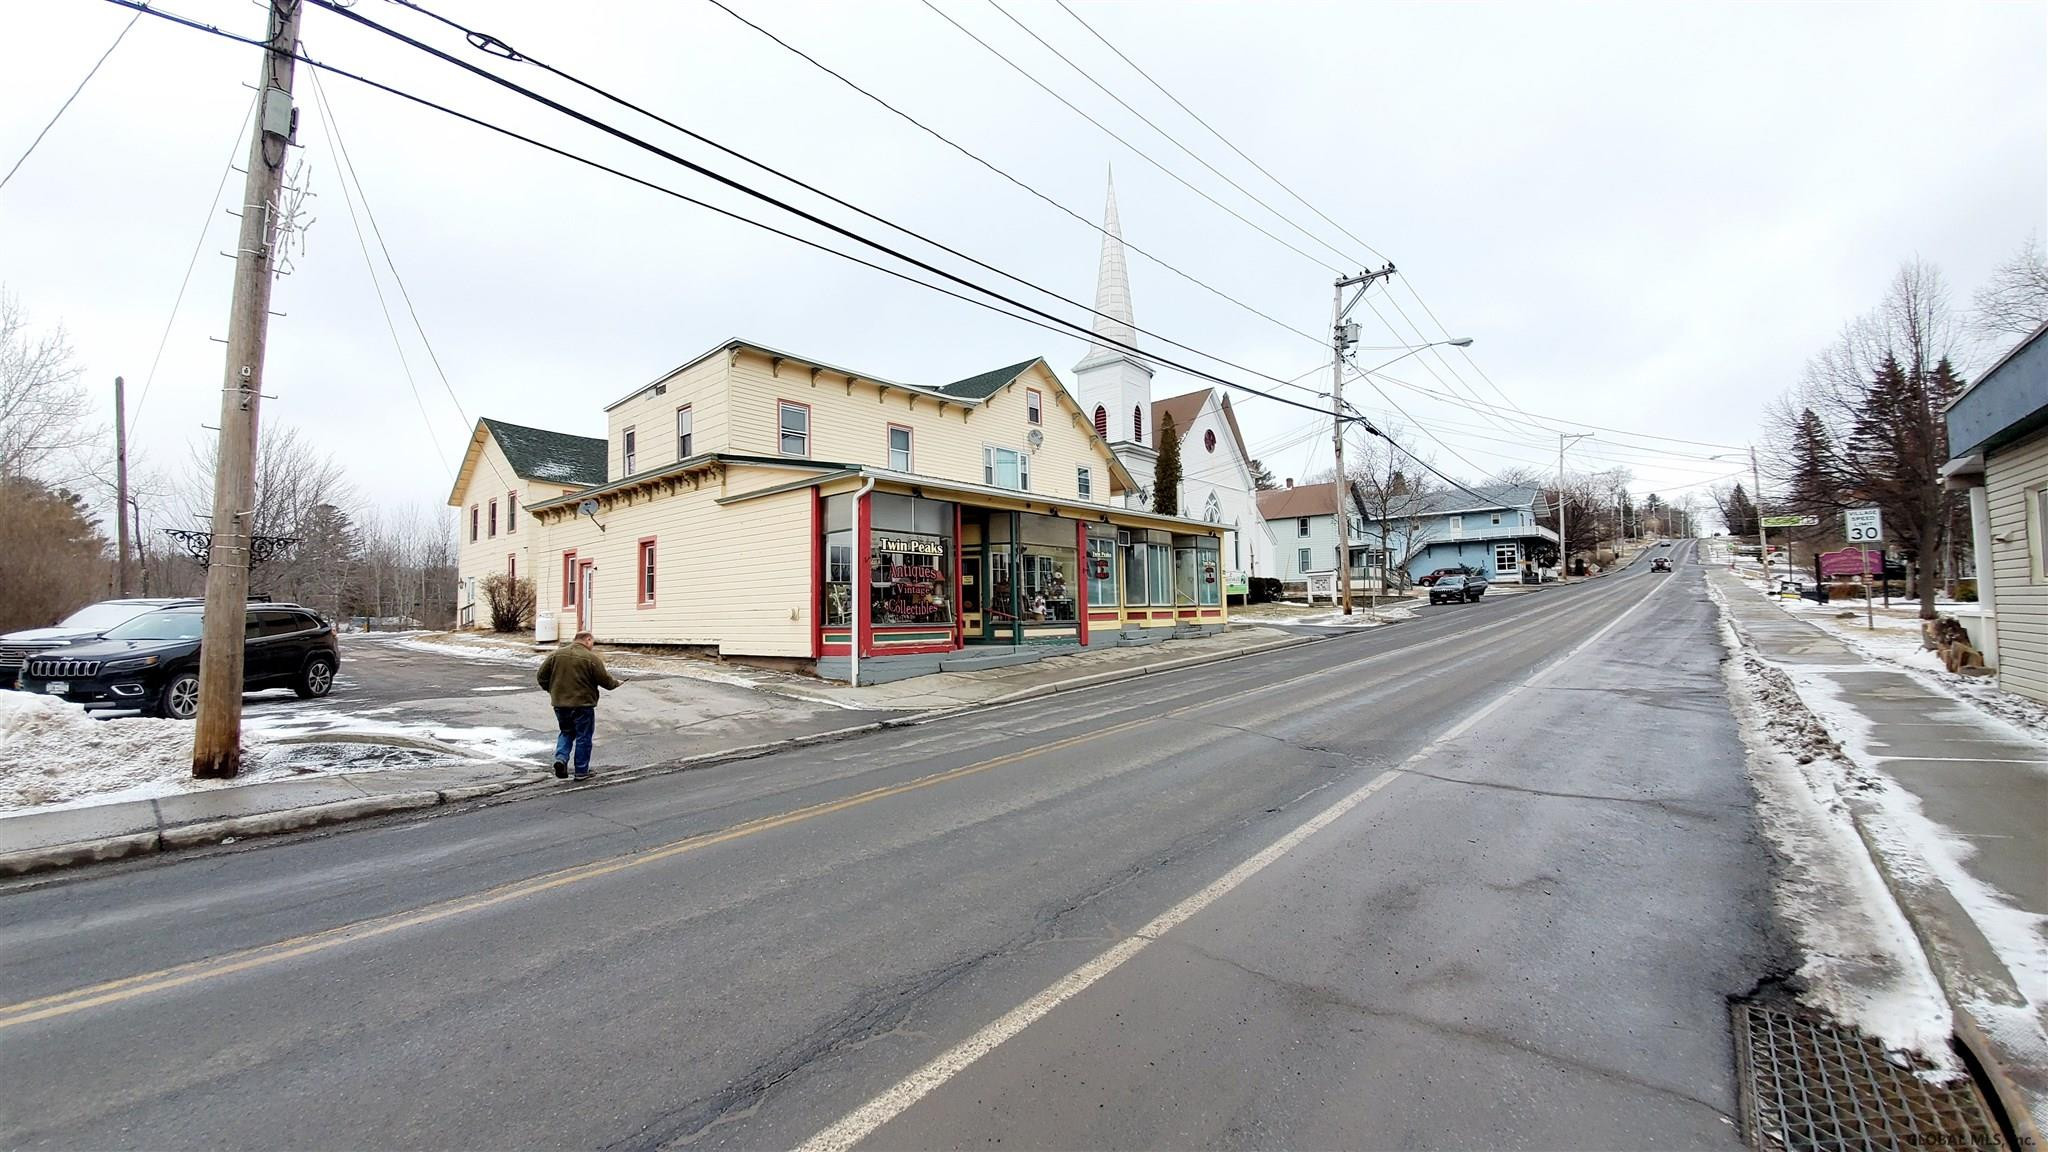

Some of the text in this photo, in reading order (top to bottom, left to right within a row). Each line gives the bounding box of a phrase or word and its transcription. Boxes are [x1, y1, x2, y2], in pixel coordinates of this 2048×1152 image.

[1851, 527, 1878, 540] 30
[880, 537, 944, 554] Twin Peaks
[889, 562, 937, 583] Antiques
[896, 583, 930, 597] Vintage
[888, 599, 938, 615] Collectibles
